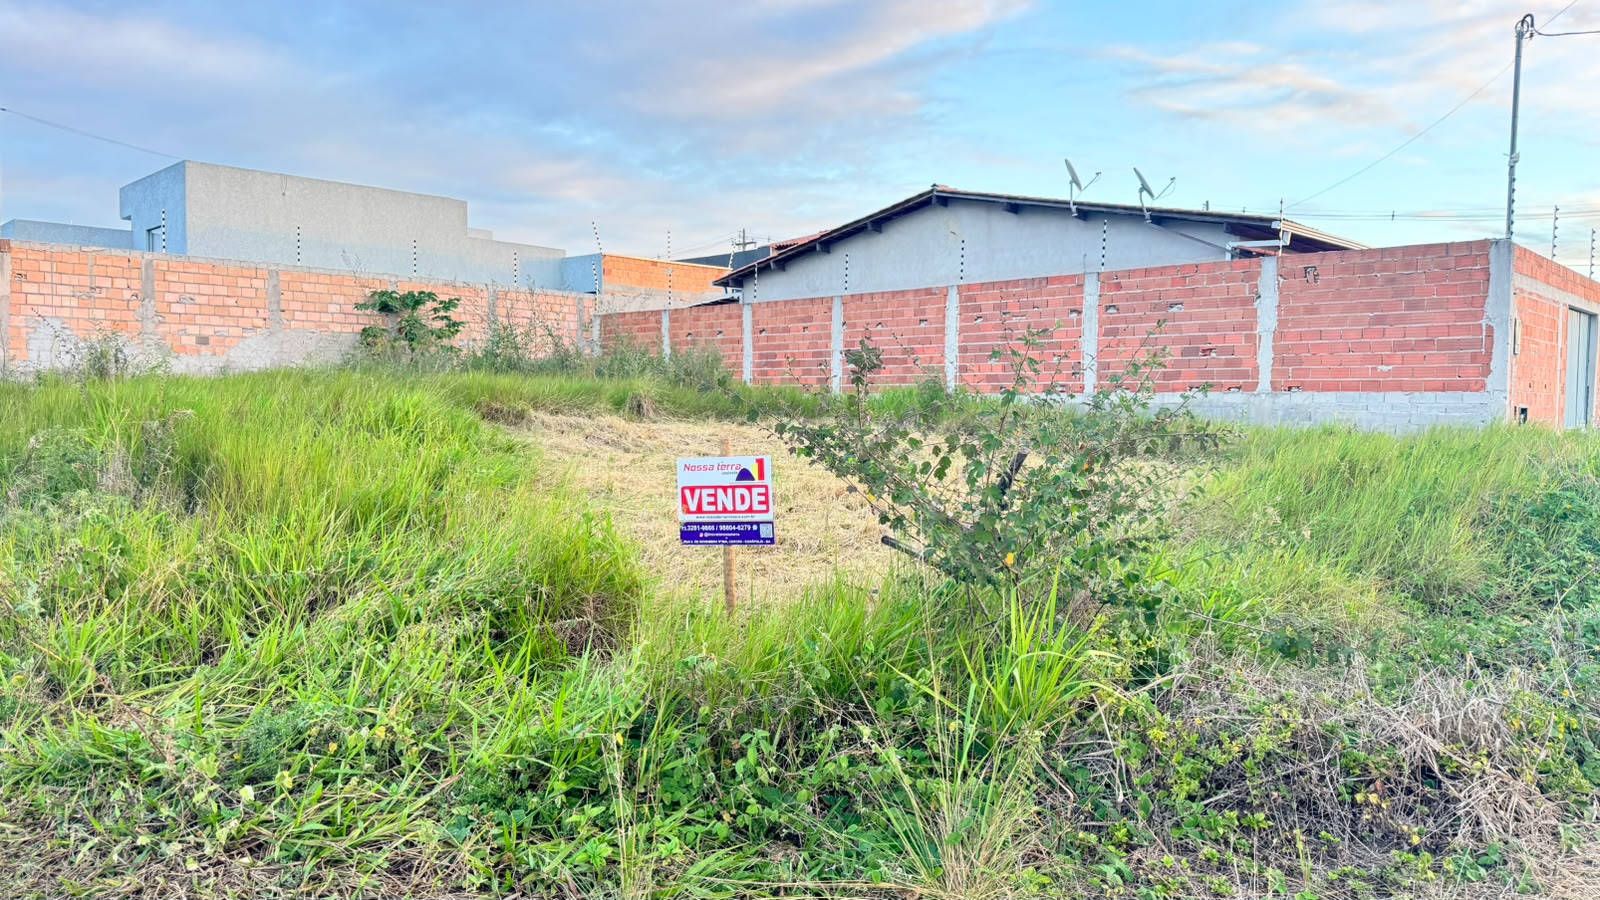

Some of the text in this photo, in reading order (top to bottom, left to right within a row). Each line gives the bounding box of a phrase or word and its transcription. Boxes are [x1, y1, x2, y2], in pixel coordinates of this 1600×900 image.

[683, 462, 741, 471] Nossa terra
[683, 487, 767, 512] VENDE
